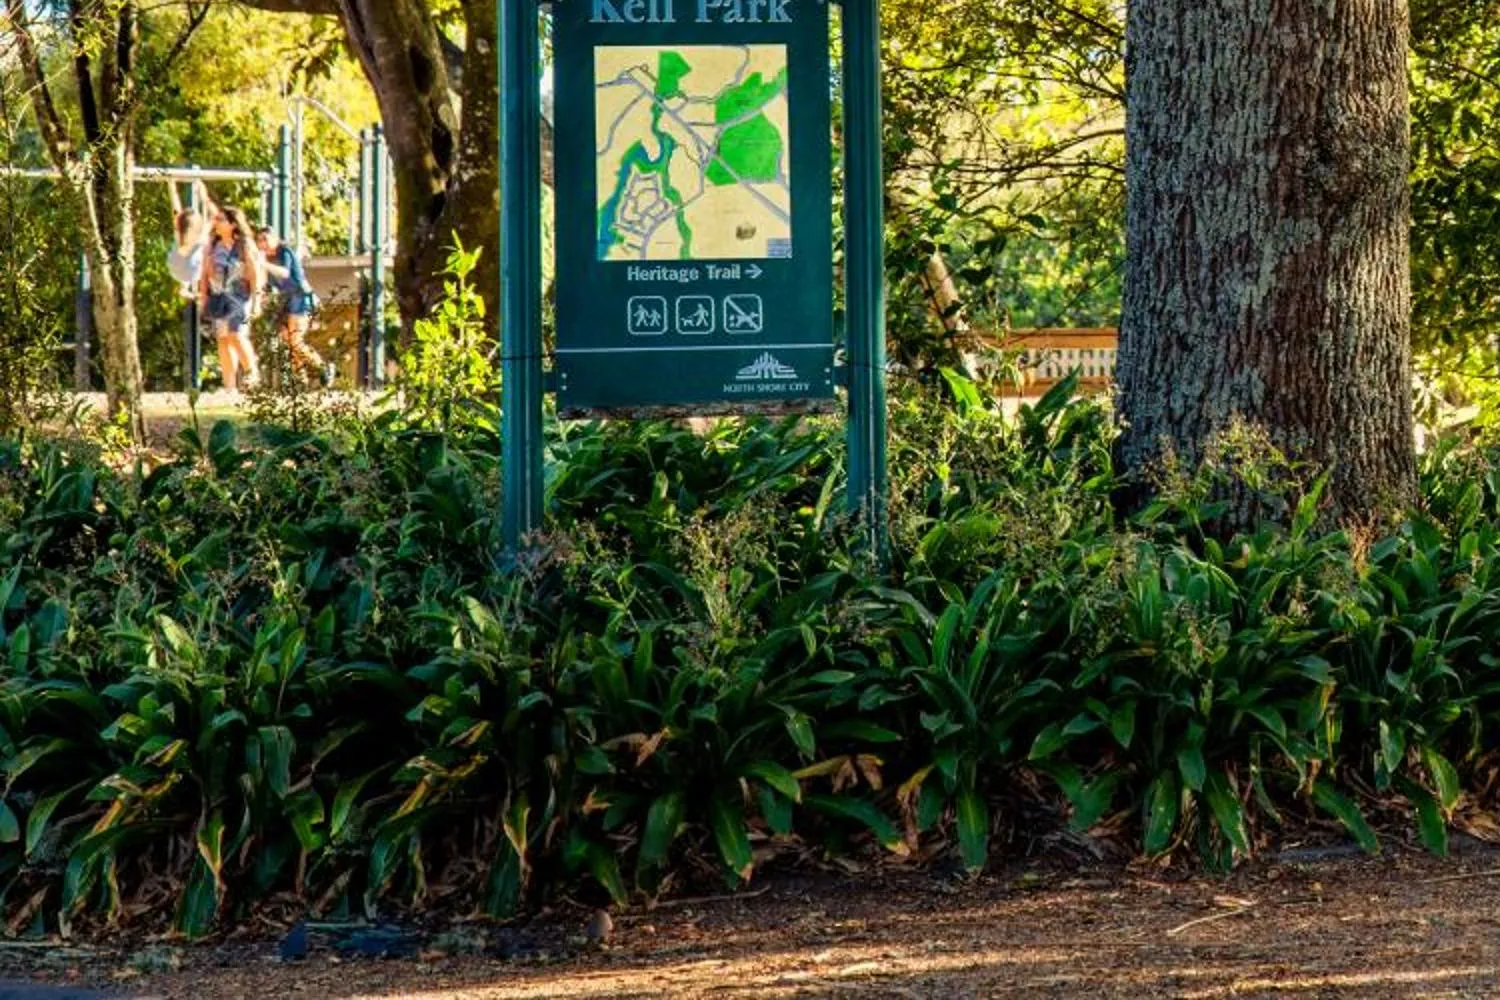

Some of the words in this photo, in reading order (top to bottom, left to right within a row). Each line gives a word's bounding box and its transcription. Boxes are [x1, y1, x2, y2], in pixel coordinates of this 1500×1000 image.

[627, 265, 699, 283] Heritage
[705, 264, 741, 280] Trail
[723, 383, 754, 393] NORTH
[789, 382, 810, 391] CITY
